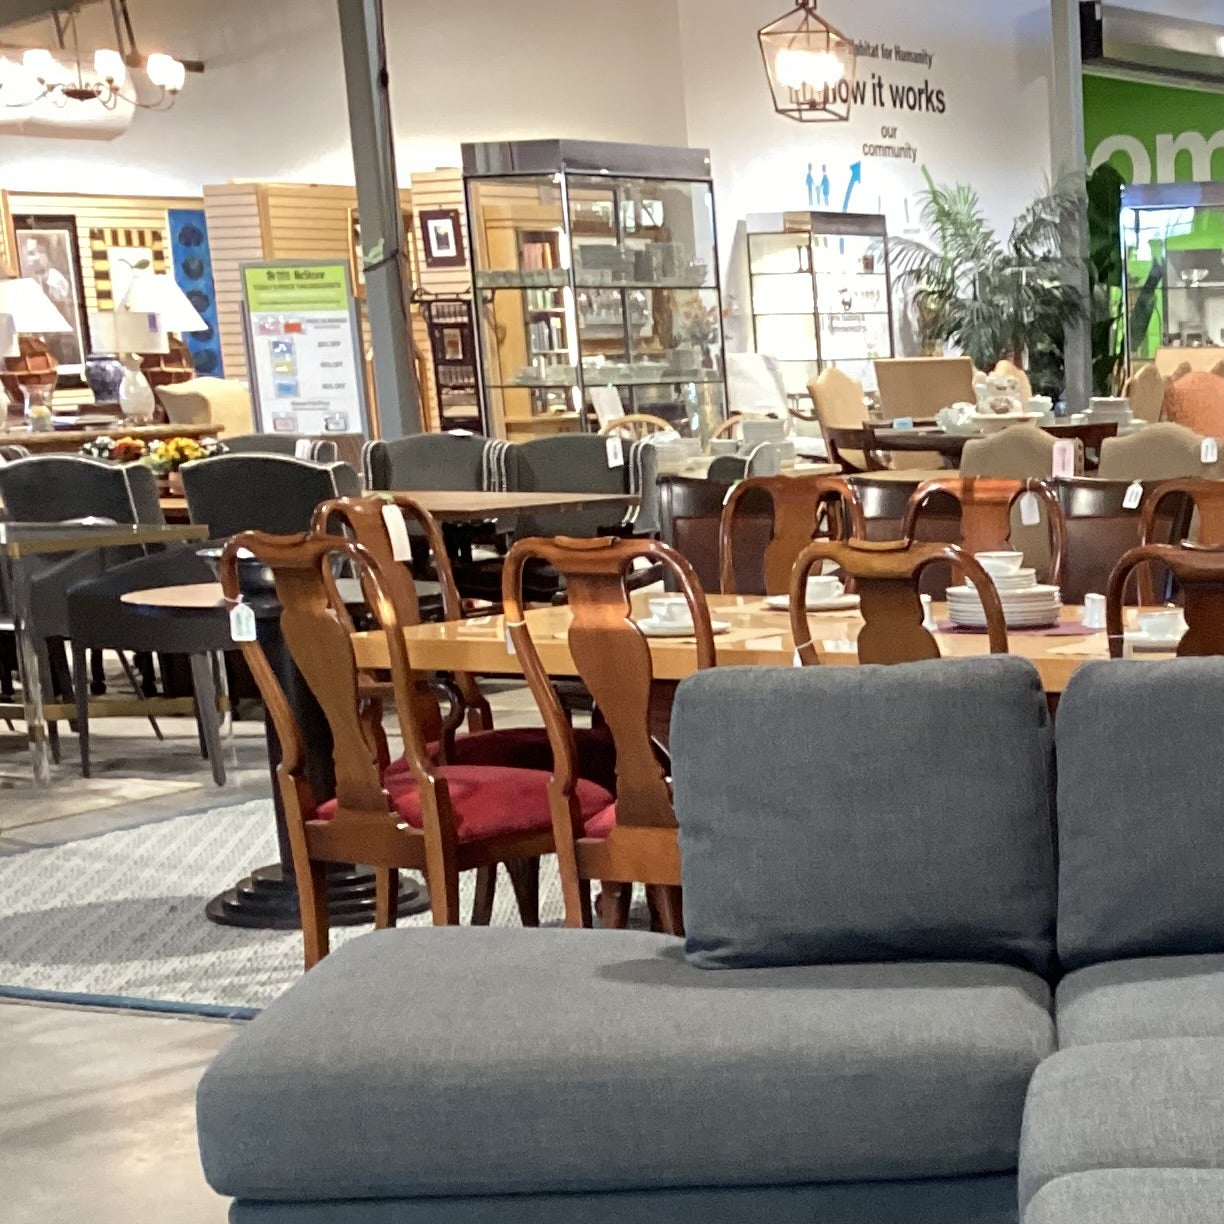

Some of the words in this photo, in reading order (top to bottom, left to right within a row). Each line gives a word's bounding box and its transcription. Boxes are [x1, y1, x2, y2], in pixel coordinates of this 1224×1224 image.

[881, 43, 893, 60] for
[894, 45, 933, 69] Humanity
[871, 73, 886, 107] it
[889, 80, 945, 113] works
[880, 125, 898, 139] our
[862, 143, 917, 163] community
